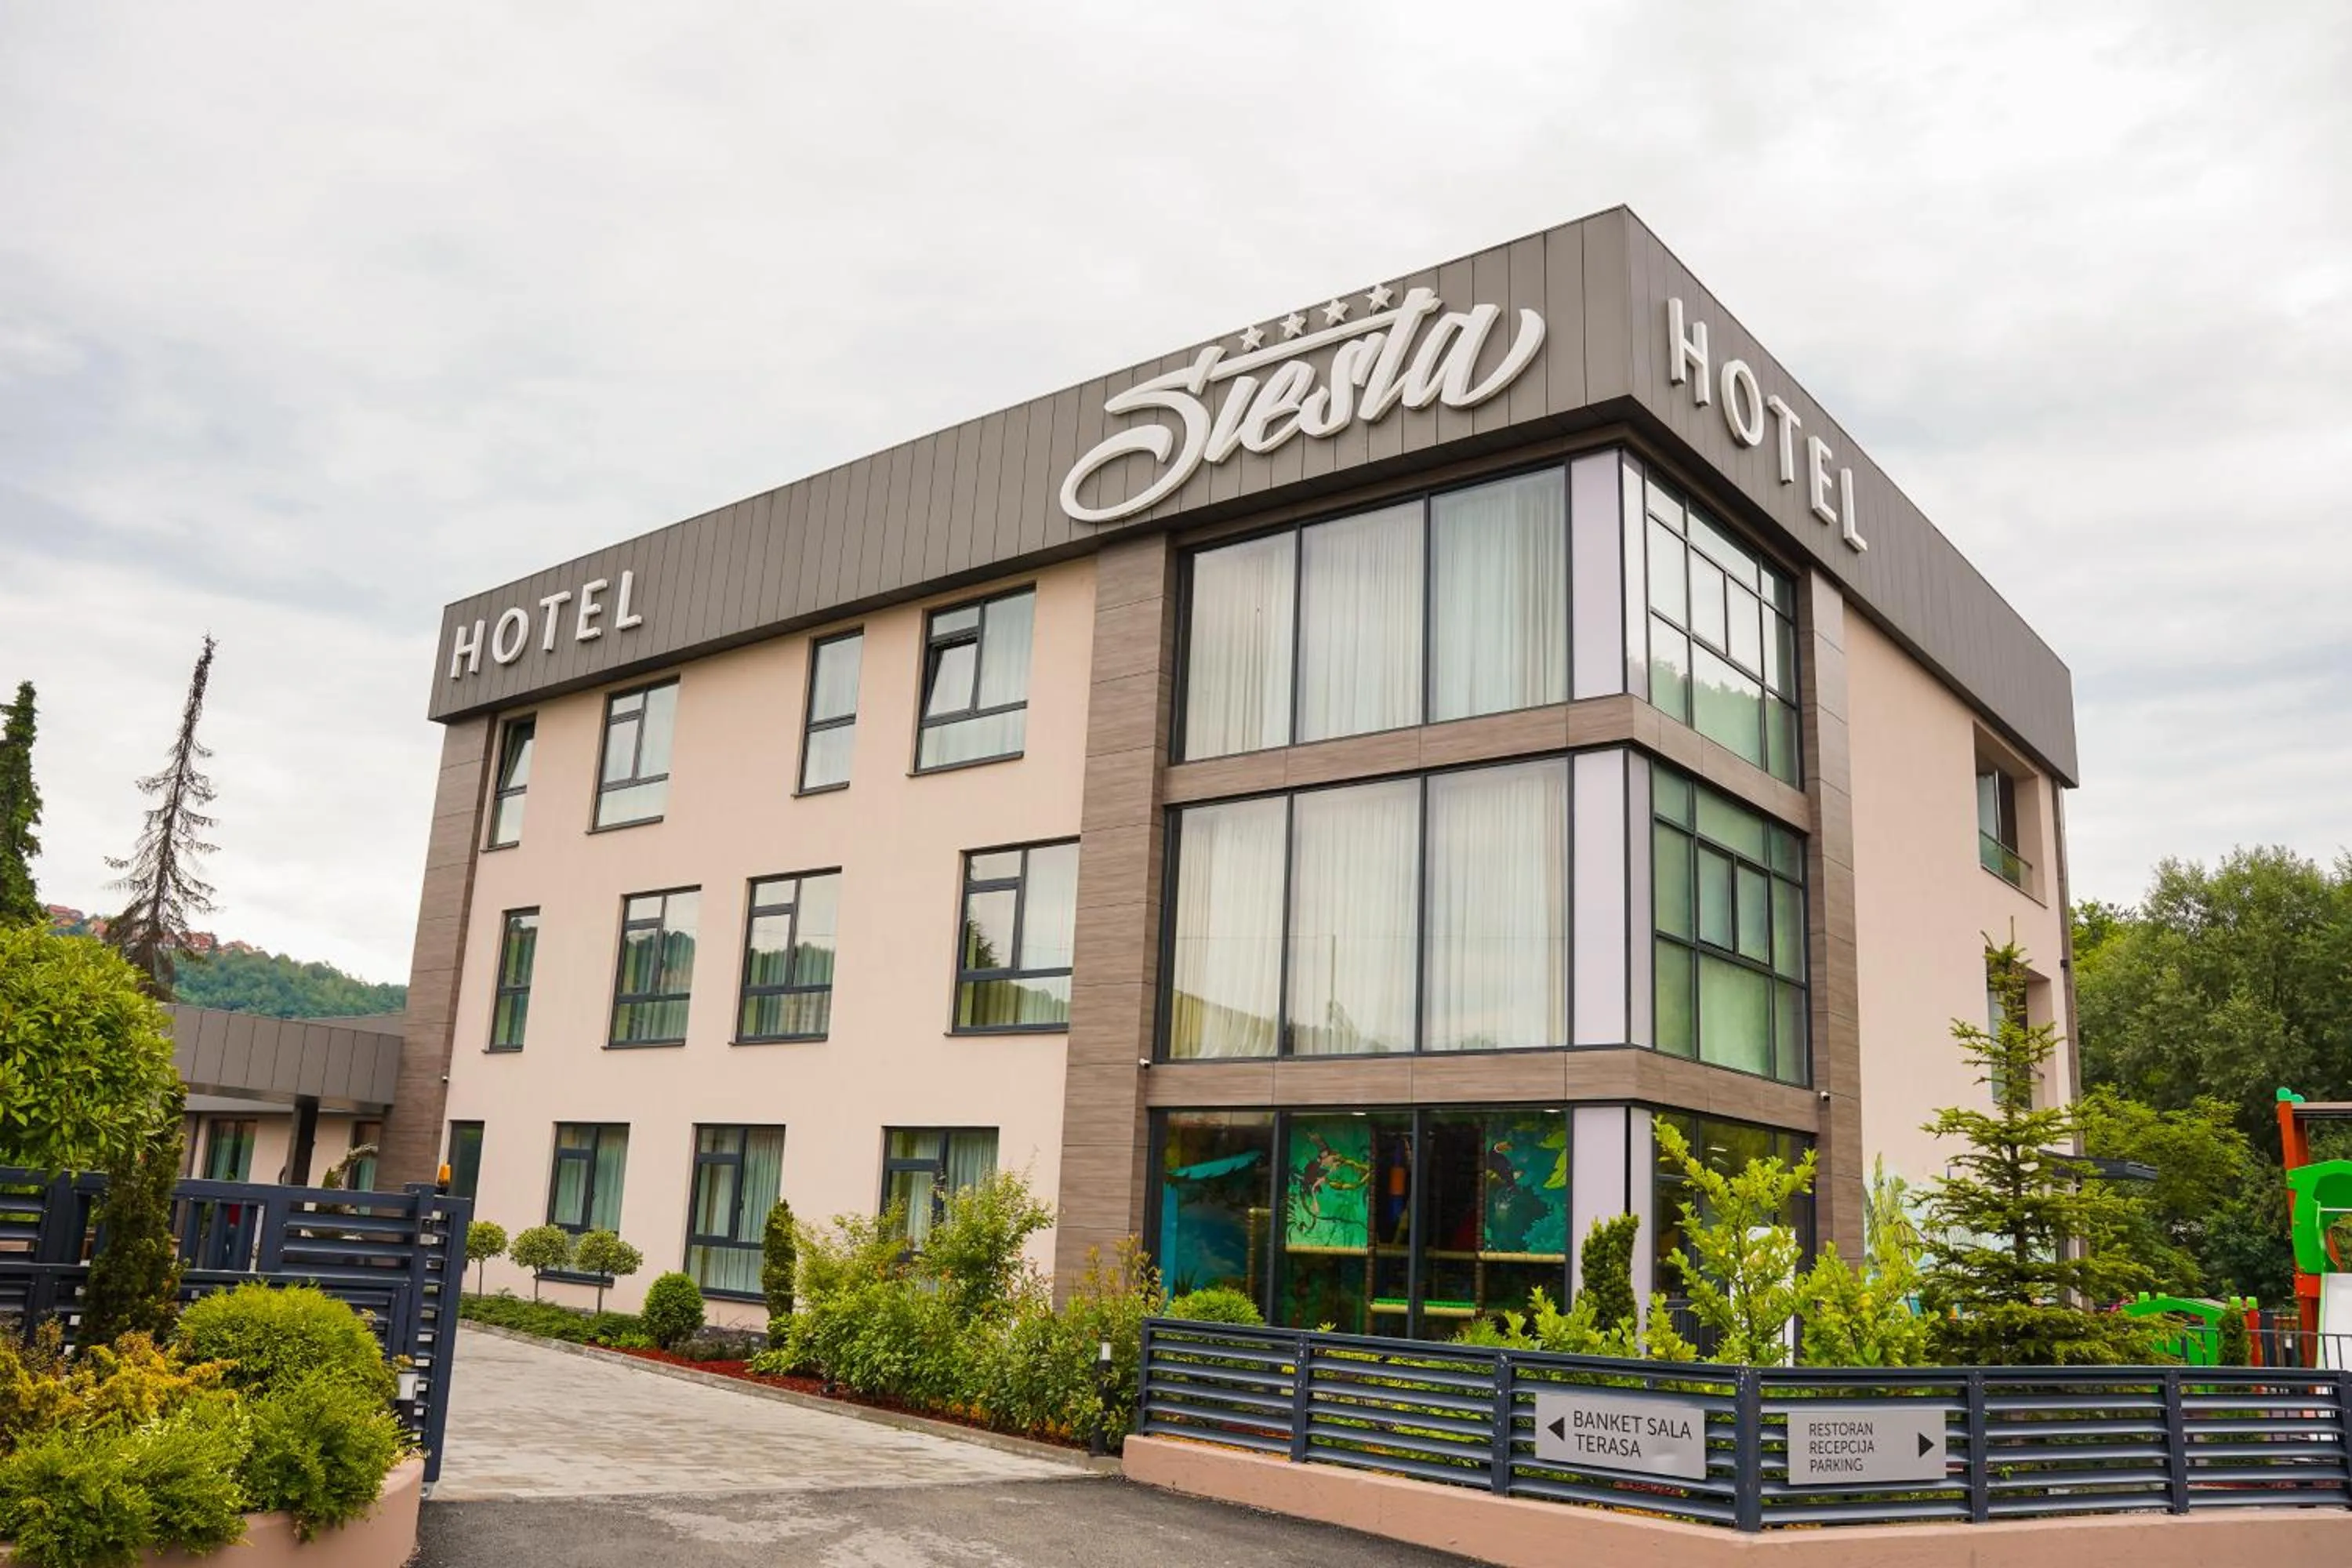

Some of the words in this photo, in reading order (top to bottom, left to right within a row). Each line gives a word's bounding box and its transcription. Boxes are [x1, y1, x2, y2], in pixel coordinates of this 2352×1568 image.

[1060, 287, 1546, 522] Siesta
[1668, 298, 1867, 553] HOTEL
[450, 570, 642, 679] HOTEL
[1573, 1410, 1642, 1434] BANKET
[1647, 1417, 1692, 1439] SALA
[1809, 1422, 1874, 1437] RESTORAN
[1574, 1434, 1641, 1457] TERASA
[1809, 1440, 1875, 1455] RECEPCIJA
[1809, 1458, 1864, 1472] PARKING
